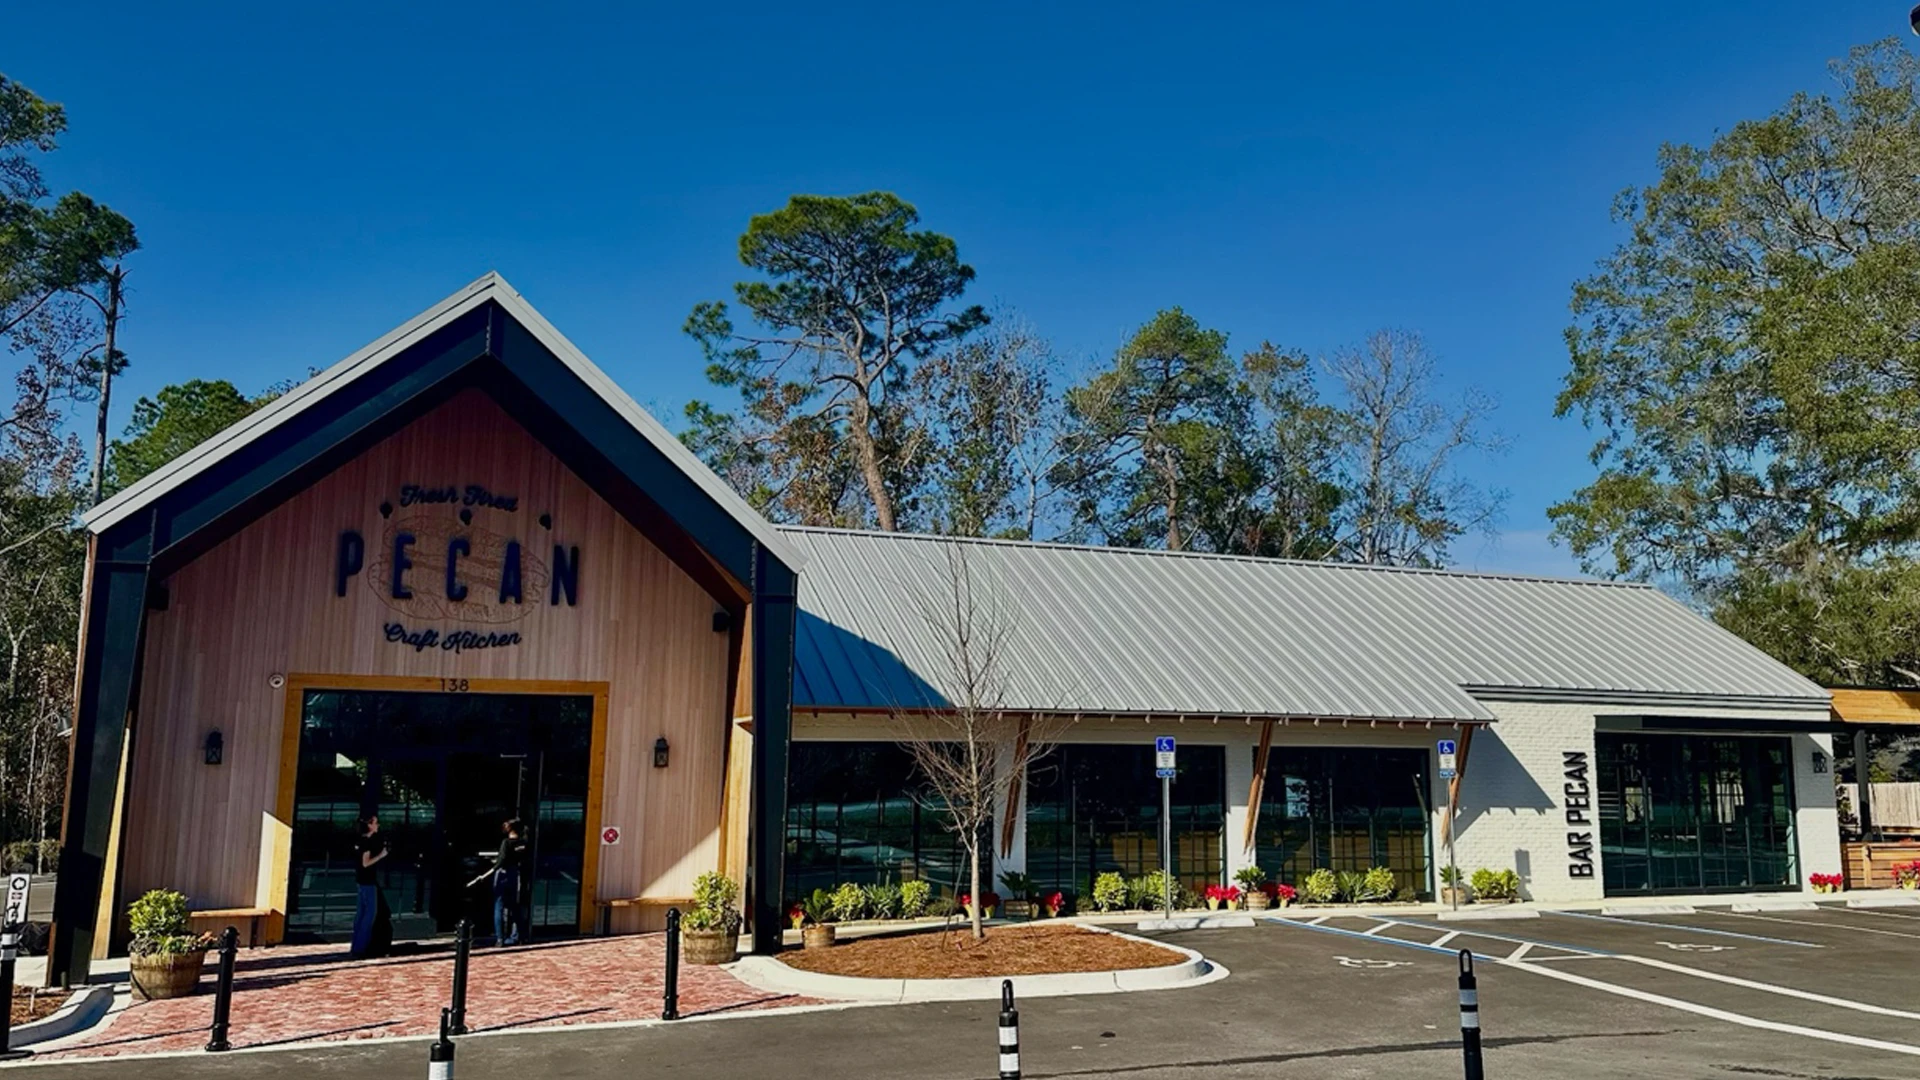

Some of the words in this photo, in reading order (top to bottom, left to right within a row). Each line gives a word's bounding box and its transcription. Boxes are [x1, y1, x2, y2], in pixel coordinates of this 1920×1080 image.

[400, 485, 459, 507] Fresh
[463, 485, 519, 512] Fired
[336, 530, 580, 607] PECAN
[384, 622, 438, 652] Craft
[441, 630, 522, 654] Kitchen
[440, 678, 469, 692] 138
[1562, 751, 1592, 826] PECAN
[1567, 832, 1594, 879] BAR
